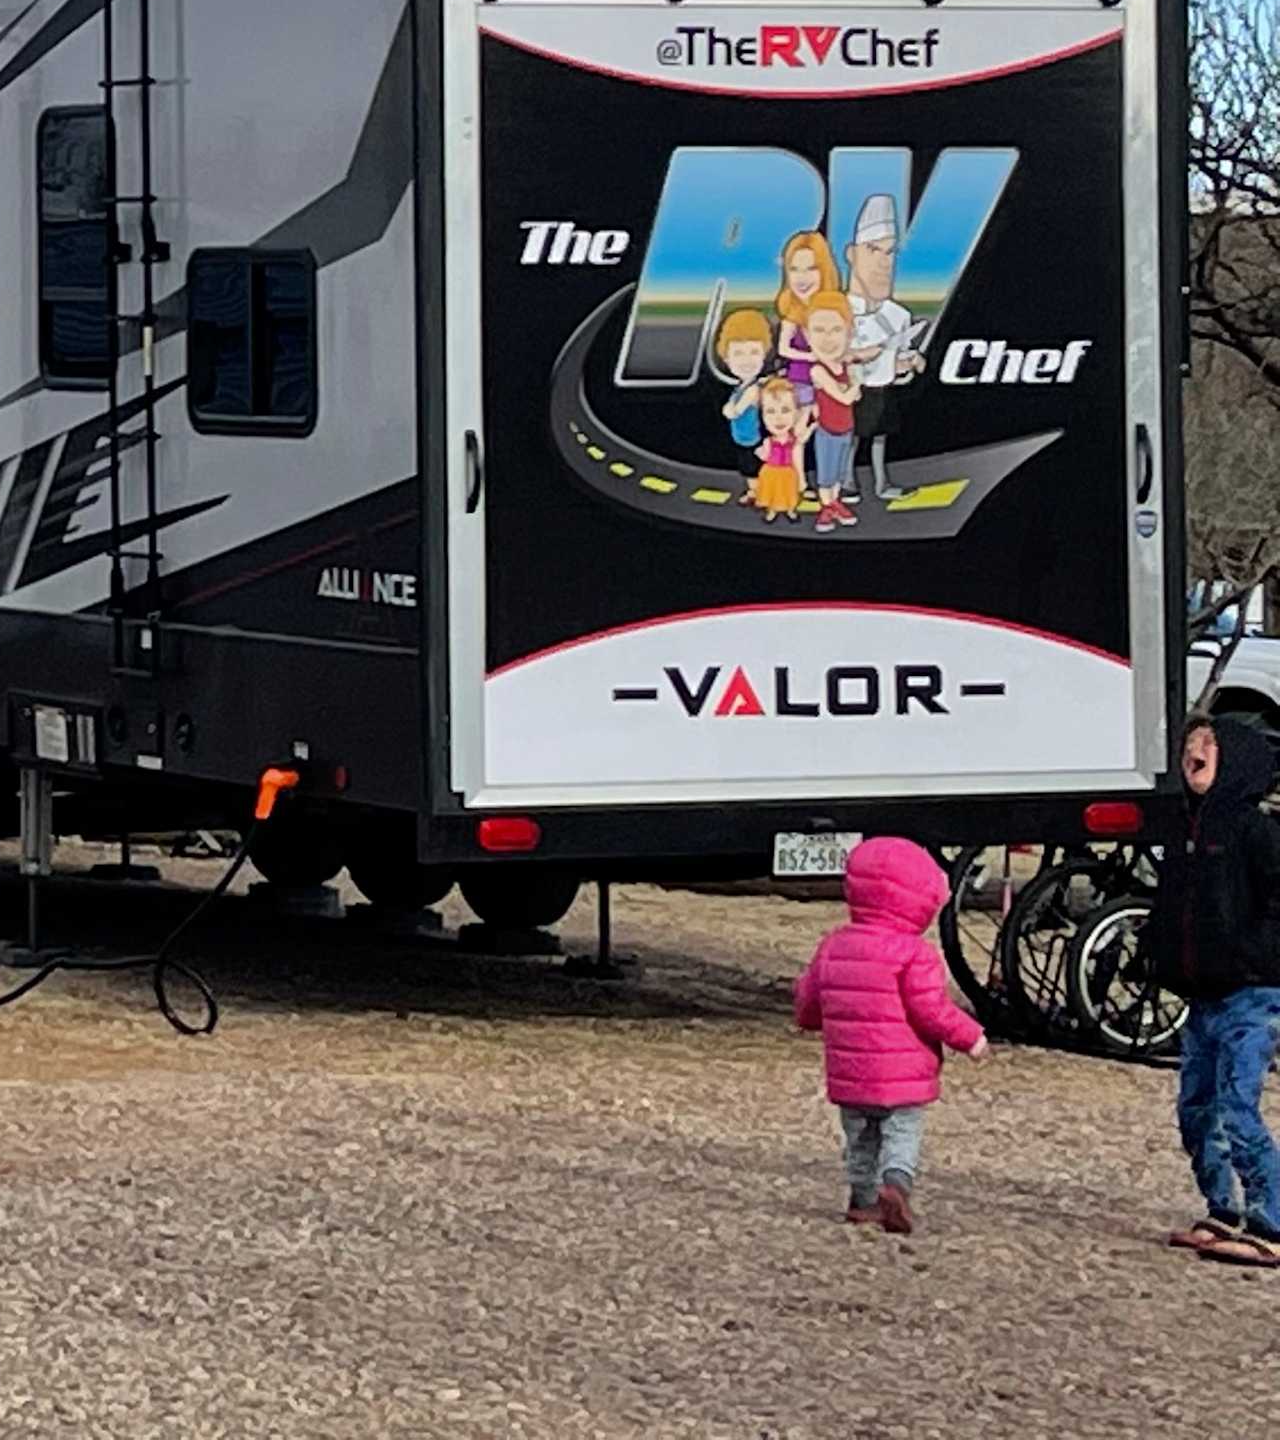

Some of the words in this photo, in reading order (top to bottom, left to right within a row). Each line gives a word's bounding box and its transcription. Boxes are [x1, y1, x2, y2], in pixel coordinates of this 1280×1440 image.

[656, 24, 940, 68] @TheRVChef
[519, 220, 631, 266] The
[614, 145, 1020, 388] RV
[938, 340, 1093, 385] Chef
